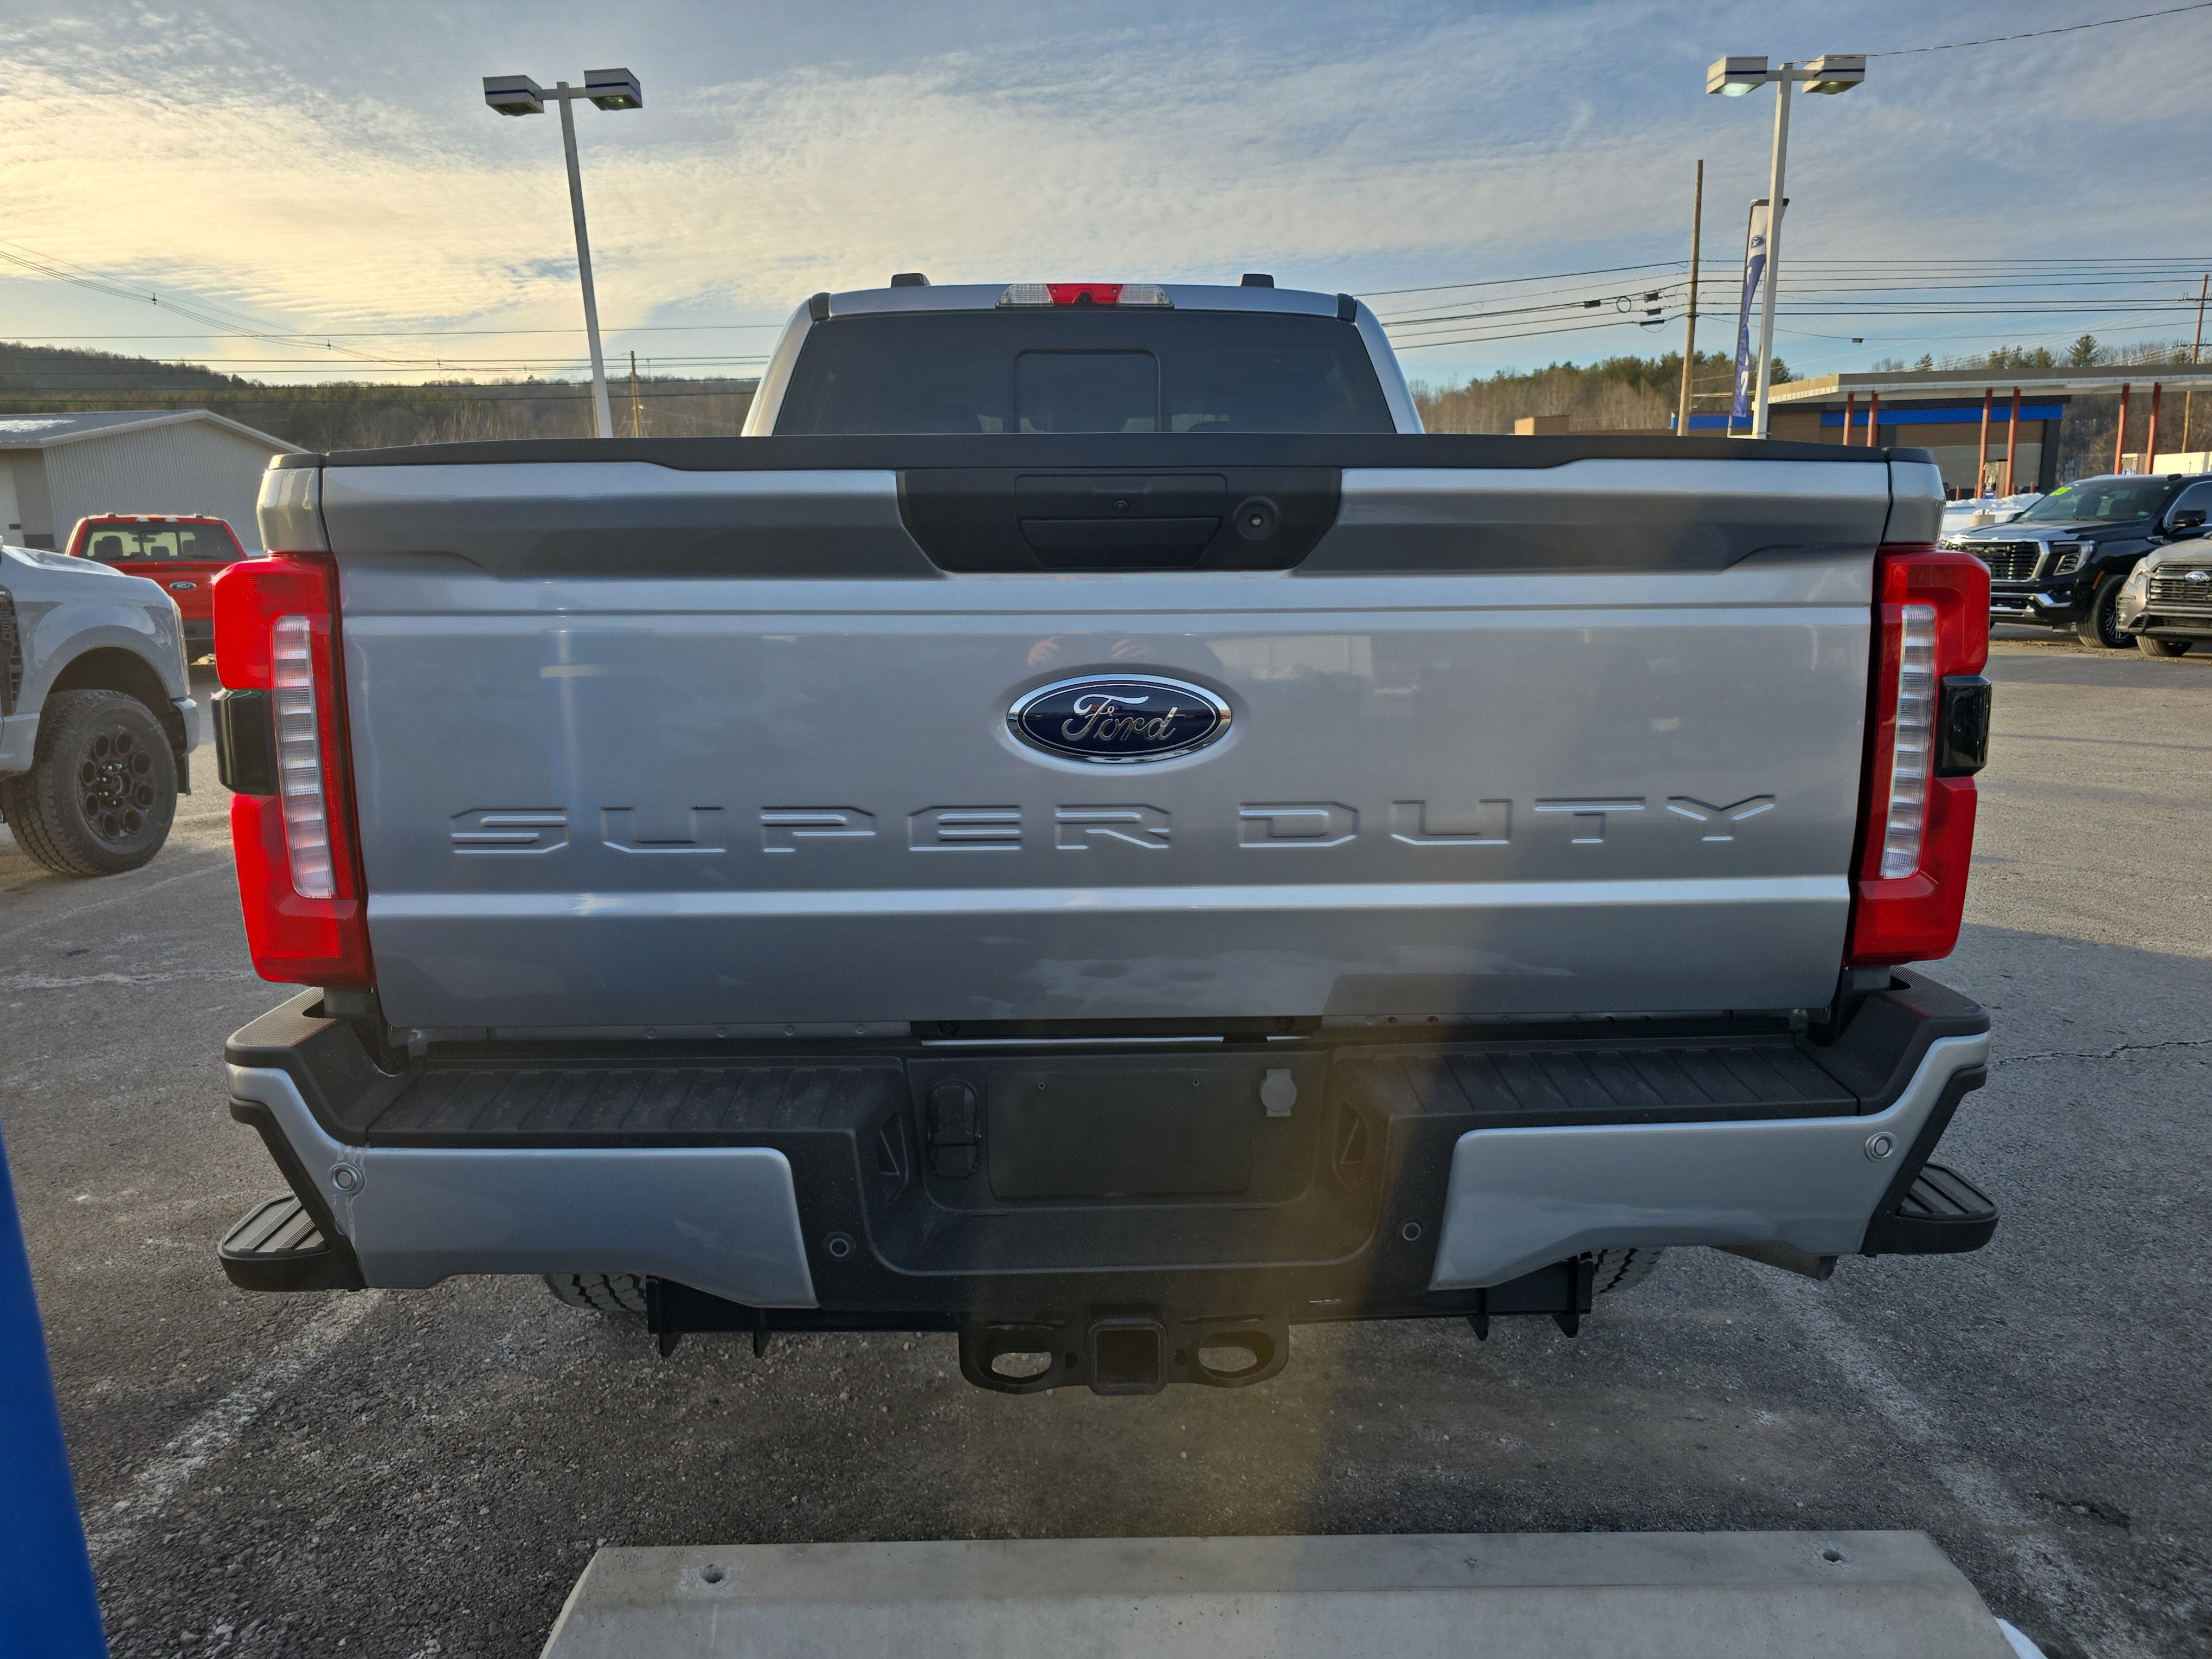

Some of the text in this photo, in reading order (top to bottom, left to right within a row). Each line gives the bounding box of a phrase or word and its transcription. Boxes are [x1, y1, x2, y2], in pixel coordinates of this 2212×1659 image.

[1061, 693, 1178, 741] Ford
[449, 794, 1776, 855] SUPER DUTY
